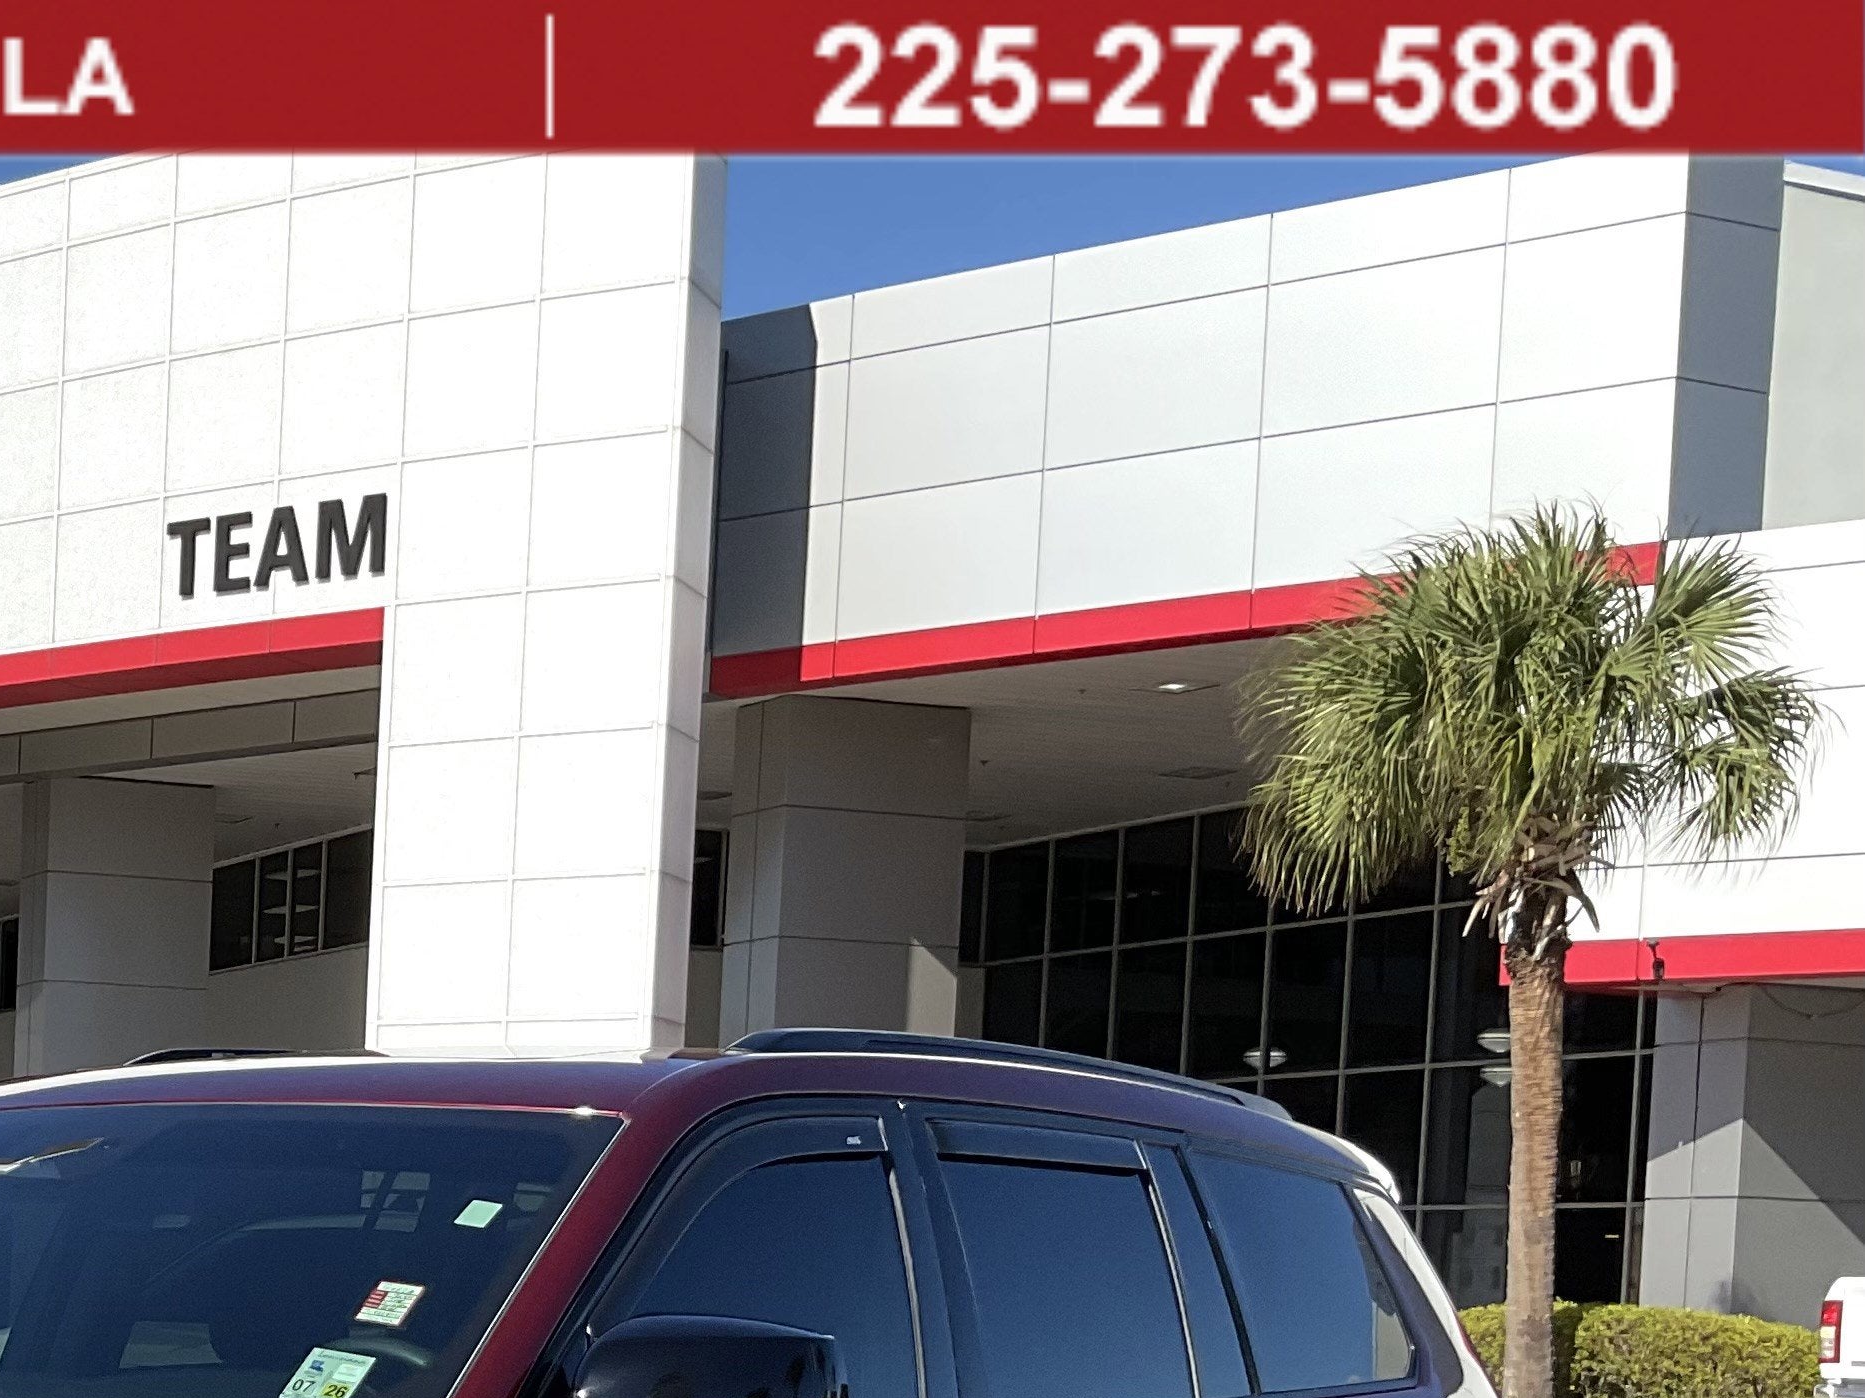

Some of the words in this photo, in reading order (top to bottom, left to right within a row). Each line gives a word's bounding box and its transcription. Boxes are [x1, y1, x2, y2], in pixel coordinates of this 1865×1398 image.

[166, 492, 388, 599] TEAM
[292, 1379, 316, 1393] 07
[324, 1384, 348, 1398] 26
